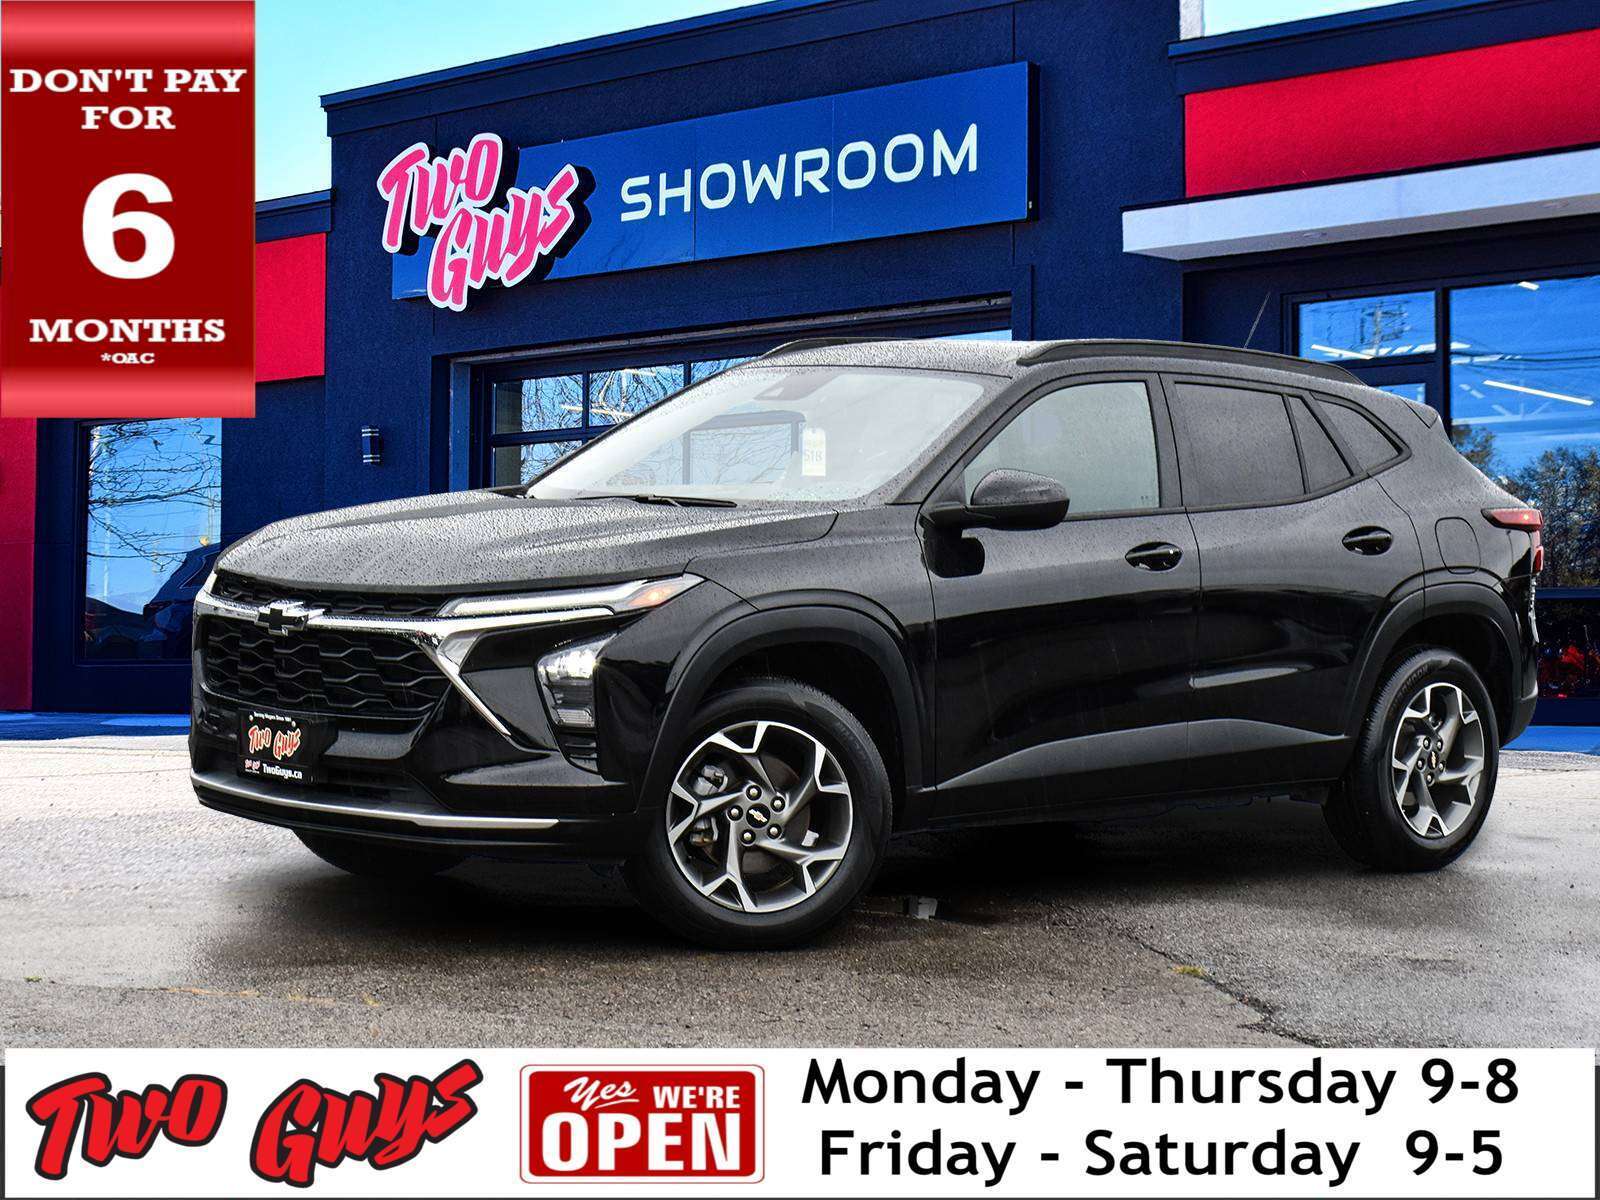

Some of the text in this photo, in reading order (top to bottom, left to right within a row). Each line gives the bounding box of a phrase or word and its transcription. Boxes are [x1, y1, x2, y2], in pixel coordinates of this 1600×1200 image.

[377, 132, 503, 254] Two
[620, 123, 978, 222] SHOWROOM
[427, 164, 580, 312] Guys
[262, 763, 303, 780] TwoGuys.ca
